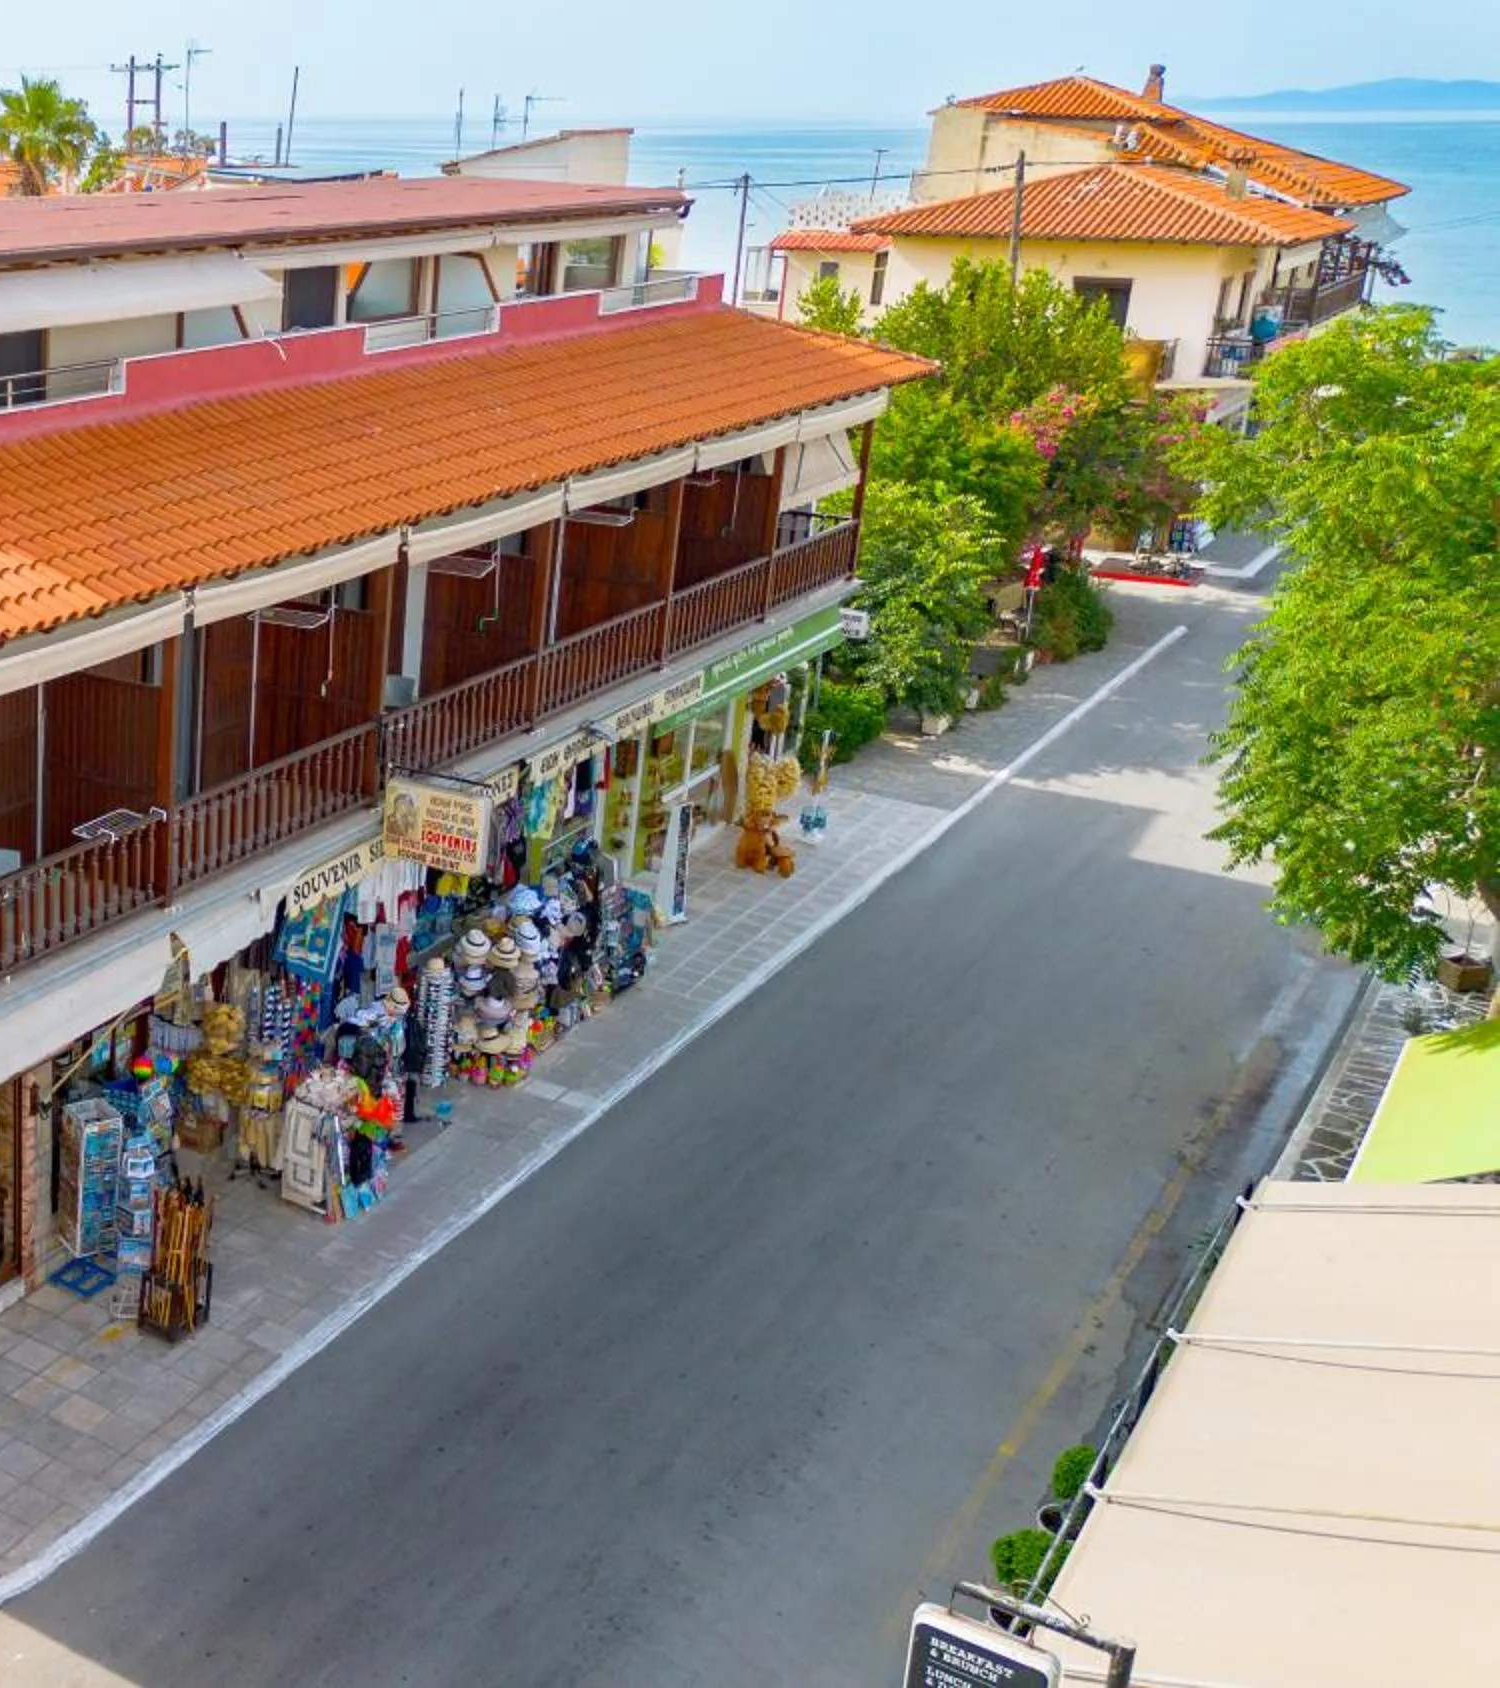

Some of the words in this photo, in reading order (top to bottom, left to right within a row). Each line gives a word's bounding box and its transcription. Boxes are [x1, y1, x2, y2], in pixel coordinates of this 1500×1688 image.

[293, 854, 362, 905] SOUVENIR
[926, 1665, 972, 1688] LUNCH
[930, 1637, 1014, 1680] BREAKFAST
[942, 1652, 998, 1684] BRUNCH
